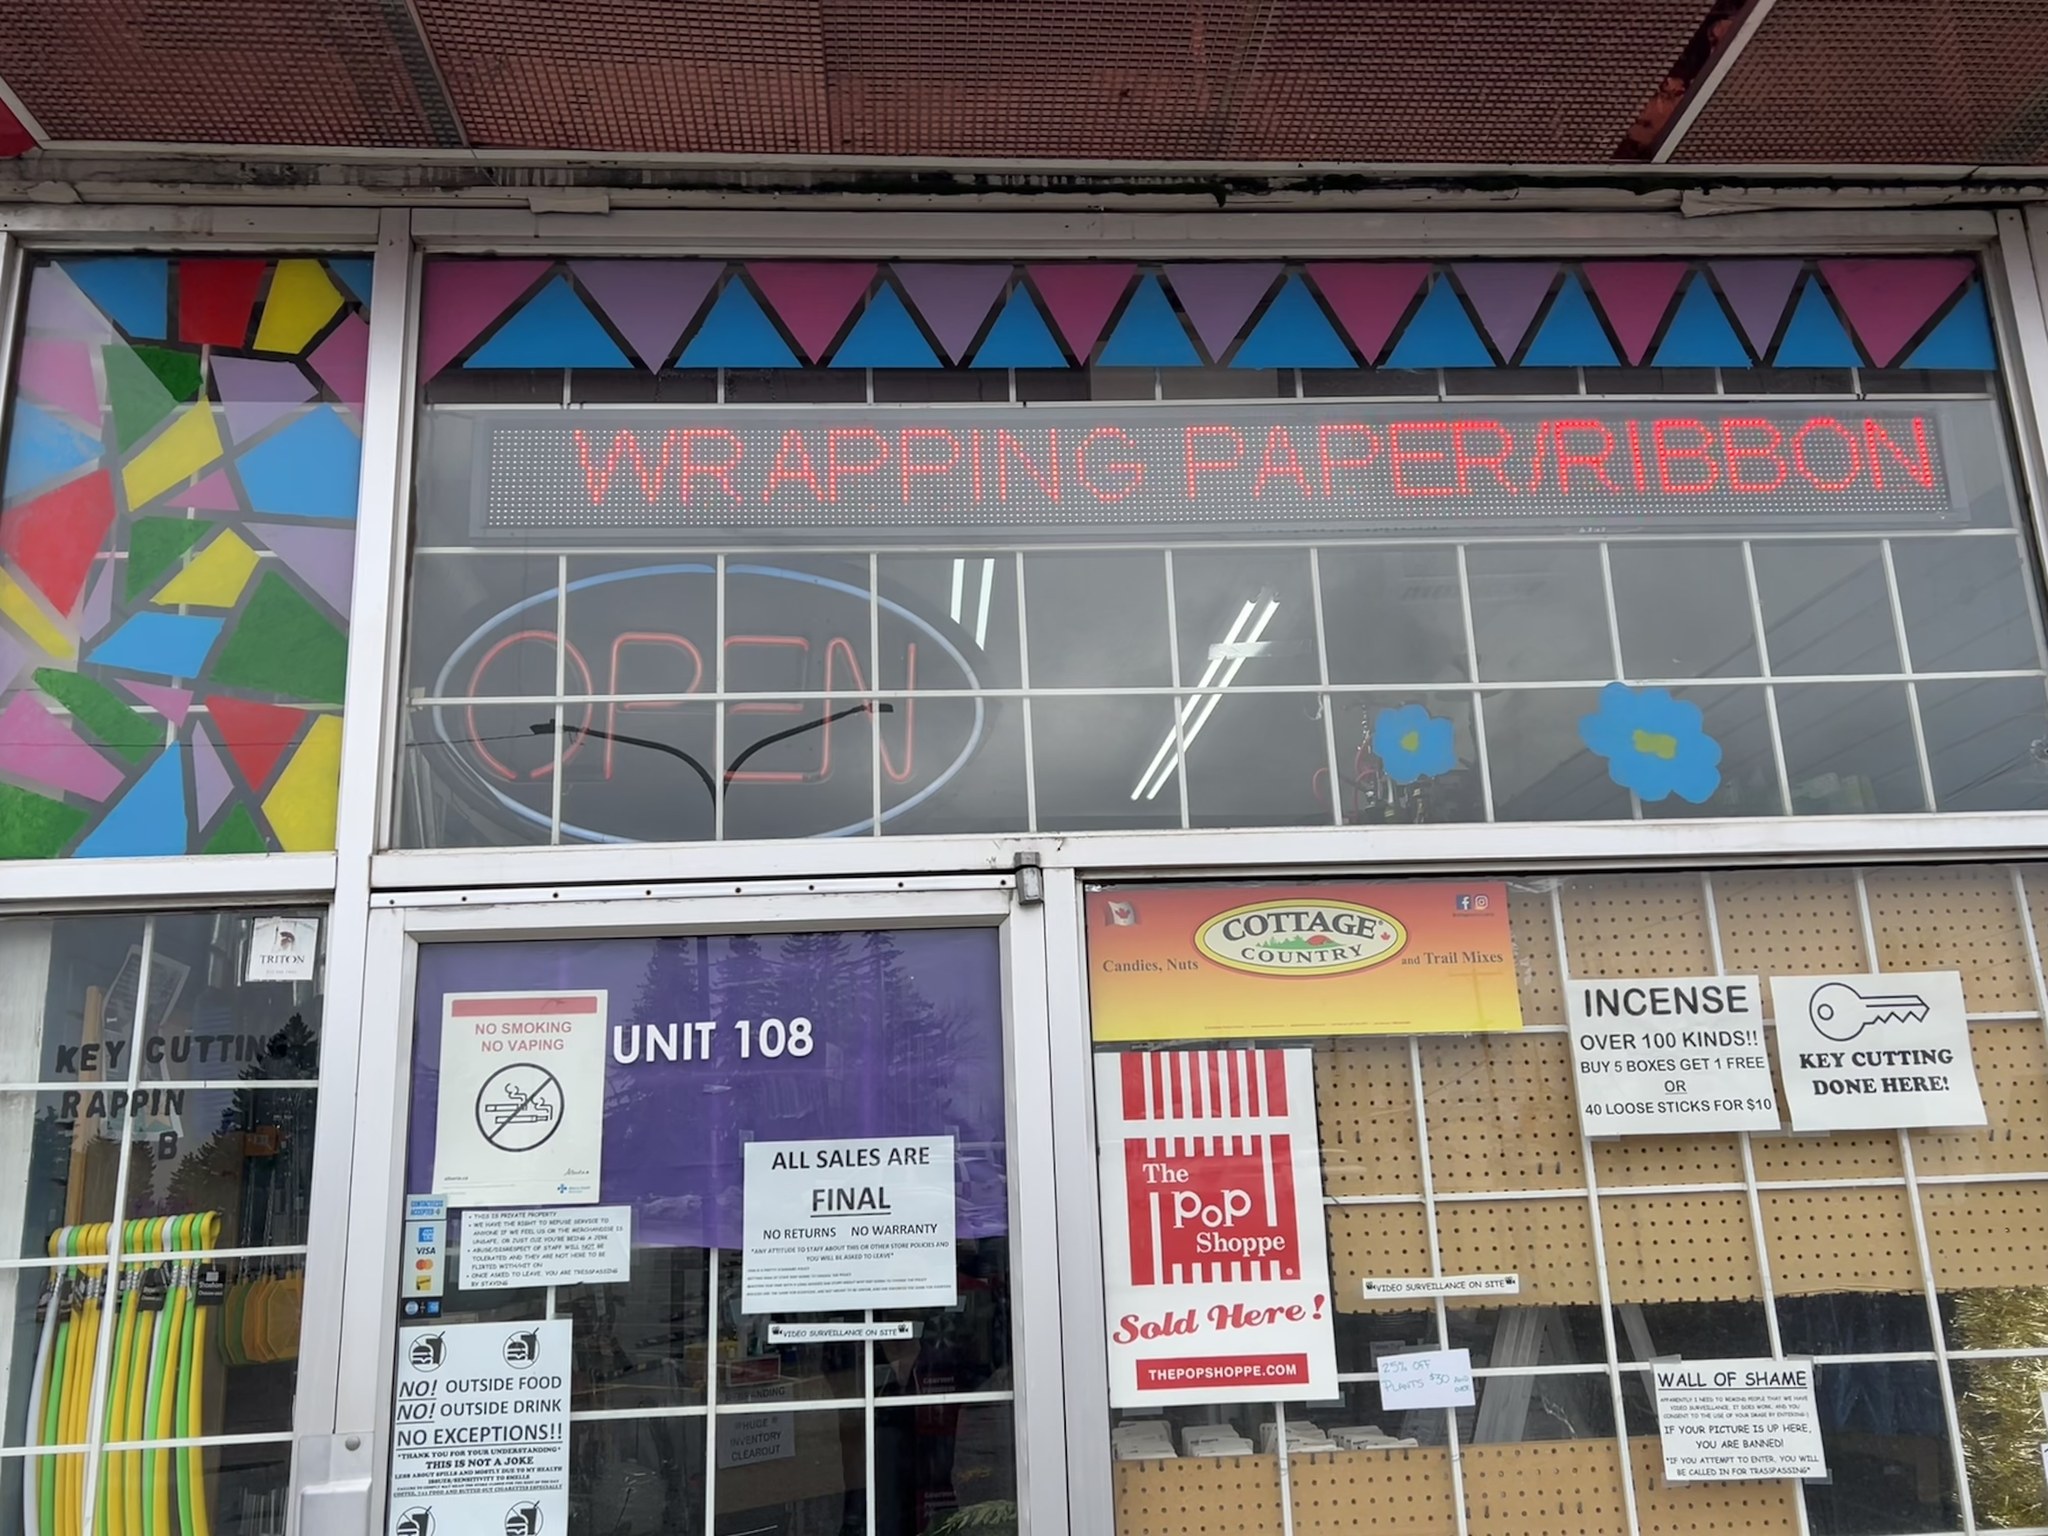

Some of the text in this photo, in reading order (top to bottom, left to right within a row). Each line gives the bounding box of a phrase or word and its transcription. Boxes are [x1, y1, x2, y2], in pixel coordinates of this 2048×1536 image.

[574, 417, 1935, 503] WRAPPING PAPER/RIBBON
[466, 630, 917, 781] OPEN
[1223, 911, 1376, 941] COTTAGE
[260, 955, 304, 963] TRITON
[1103, 950, 1503, 974] Candies, Nuts and Trail Mixes
[1241, 944, 1362, 963] COUNTRY
[1584, 985, 1749, 1017] INCENSE
[475, 1021, 572, 1035] NO SMOKING
[482, 1039, 564, 1052] NO VAPING
[613, 1017, 814, 1064] UNIT 108
[1580, 1030, 1759, 1050] OVER 100 KINDS!!
[55, 1040, 126, 1073] KEY
[1581, 1061, 1610, 1073] BUY
[1614, 1060, 1622, 1072] 5
[1627, 1059, 1675, 1072] BOXES
[1680, 1058, 1710, 1071] GET
[1727, 1056, 1765, 1070] FREE
[1799, 1049, 1954, 1069] KEY CUTTING
[1665, 1080, 1686, 1093] OR
[1813, 1076, 1949, 1096] DONE HERE!
[1585, 1098, 1772, 1115] 40 LOOSE STICKS FOR $10
[772, 1147, 930, 1170] ALL SALES ARE
[1142, 1164, 1189, 1184] The
[811, 1186, 891, 1212] FINAL
[763, 1224, 938, 1240] NO RETURNS NO WARRANTY
[1196, 1232, 1285, 1257] Shoppe
[1376, 1284, 1402, 1292] VIDEO
[1406, 1282, 1466, 1291] SURVEILLANCE
[1113, 1309, 1199, 1345] Sold
[1148, 1364, 1297, 1381] THEPOPSHOPPE.COM
[1658, 1371, 1806, 1387] WALL OF SHAME
[400, 1376, 562, 1397] NO! OUTSIDE FOOD
[397, 1400, 562, 1420] NO! OUTSIDE DRINK
[398, 1423, 562, 1446] NO EXCEPTIONS!!
[730, 1431, 781, 1447] INVENTORY
[1664, 1426, 1674, 1434] IF
[1679, 1426, 1705, 1434] YOUR
[1709, 1425, 1750, 1433] PICTURE
[732, 1445, 780, 1461] CLEAROUT
[1696, 1439, 1783, 1449] YOU ARE BANNED!
[426, 1461, 451, 1469] THIS
[455, 1460, 465, 1468] IS
[468, 1459, 492, 1467] NOT
[1689, 1468, 1717, 1476] CALLED
